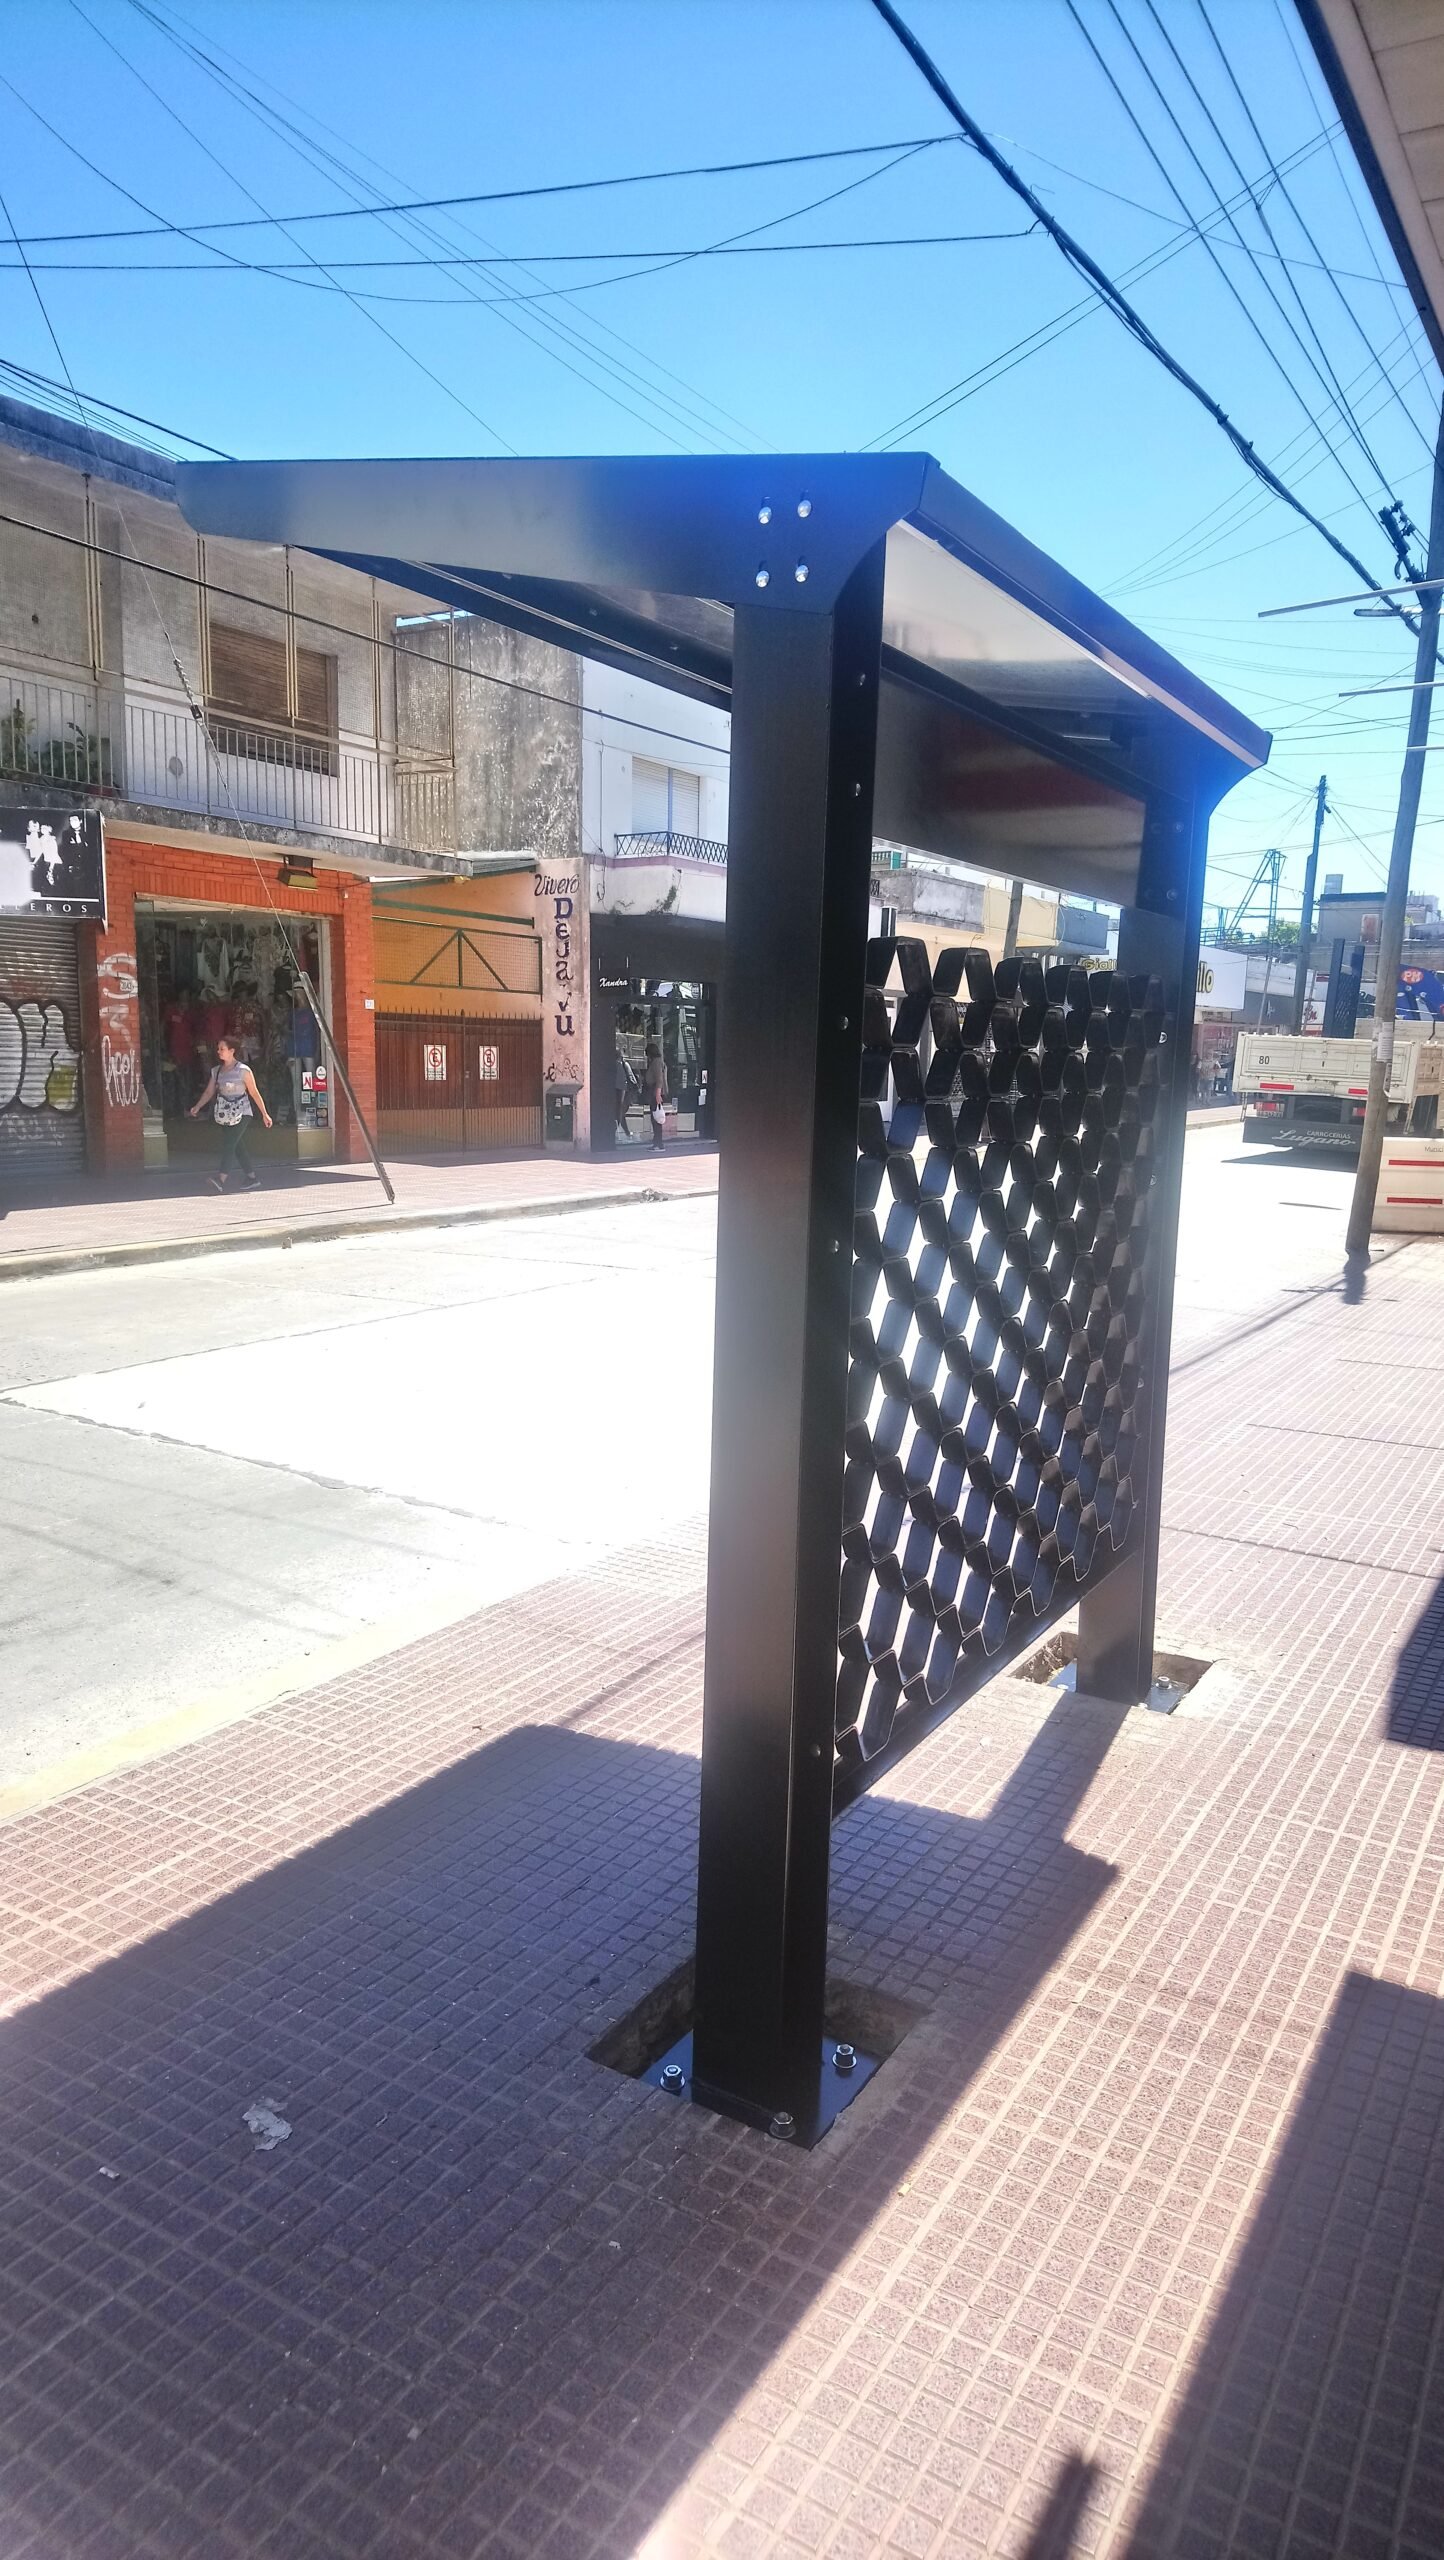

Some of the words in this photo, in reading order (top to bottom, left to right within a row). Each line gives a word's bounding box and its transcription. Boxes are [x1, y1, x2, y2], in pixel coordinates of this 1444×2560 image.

[533, 873, 580, 897] Vivero
[599, 977, 629, 987] Xandra
[1196, 960, 1215, 994] llo
[1258, 1055, 1270, 1065] 80
[1271, 1129, 1356, 1147] Lugano
[1306, 1130, 1351, 1139] CARROCERIAS
